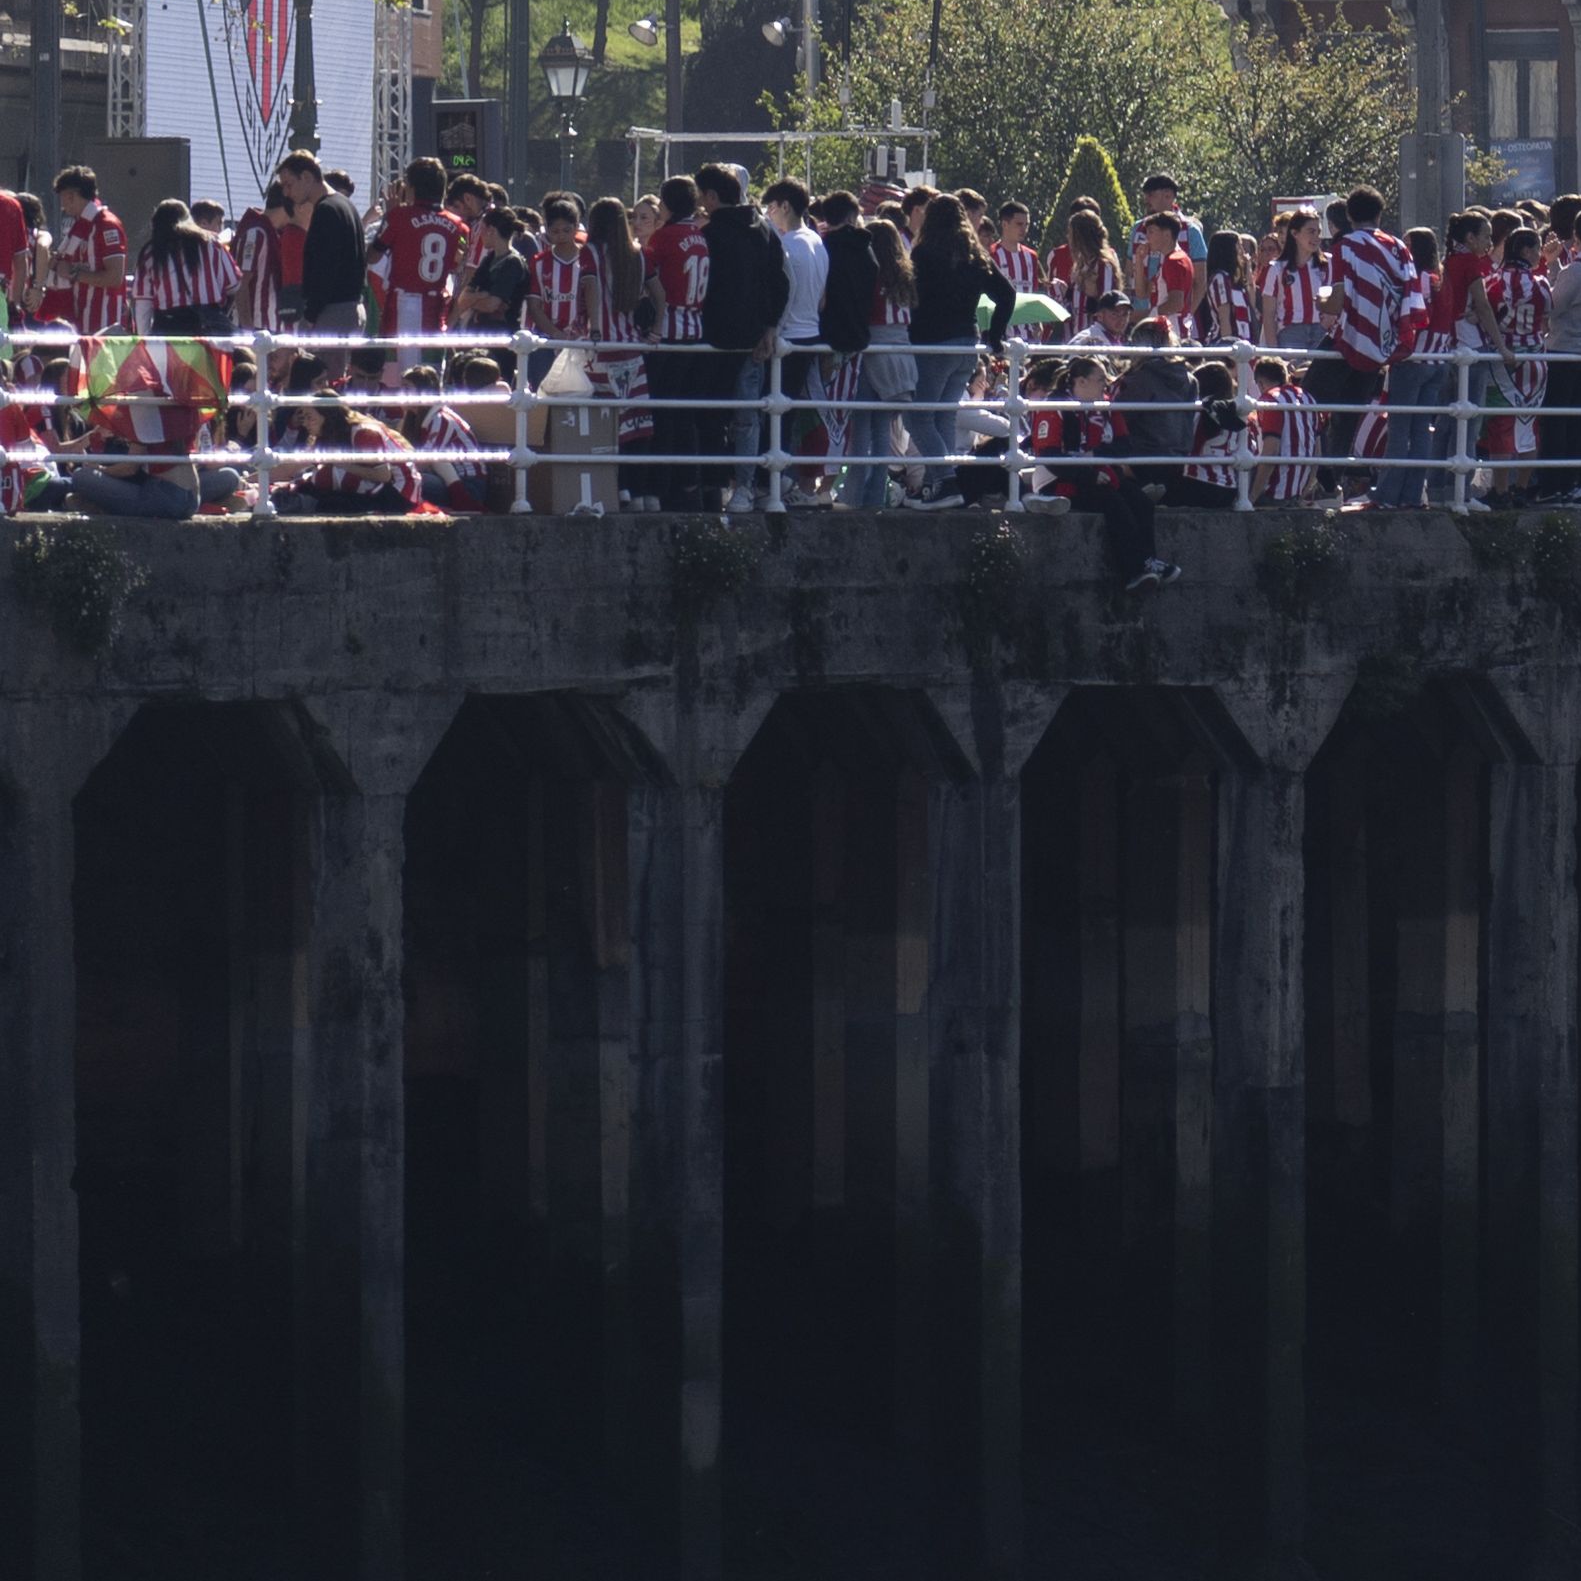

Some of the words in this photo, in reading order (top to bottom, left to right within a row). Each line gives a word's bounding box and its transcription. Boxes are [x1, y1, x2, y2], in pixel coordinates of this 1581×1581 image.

[246, 82, 288, 177] BILBAO
[418, 232, 447, 283] 8
[683, 254, 710, 305] 18
[1497, 300, 1536, 335] 20
